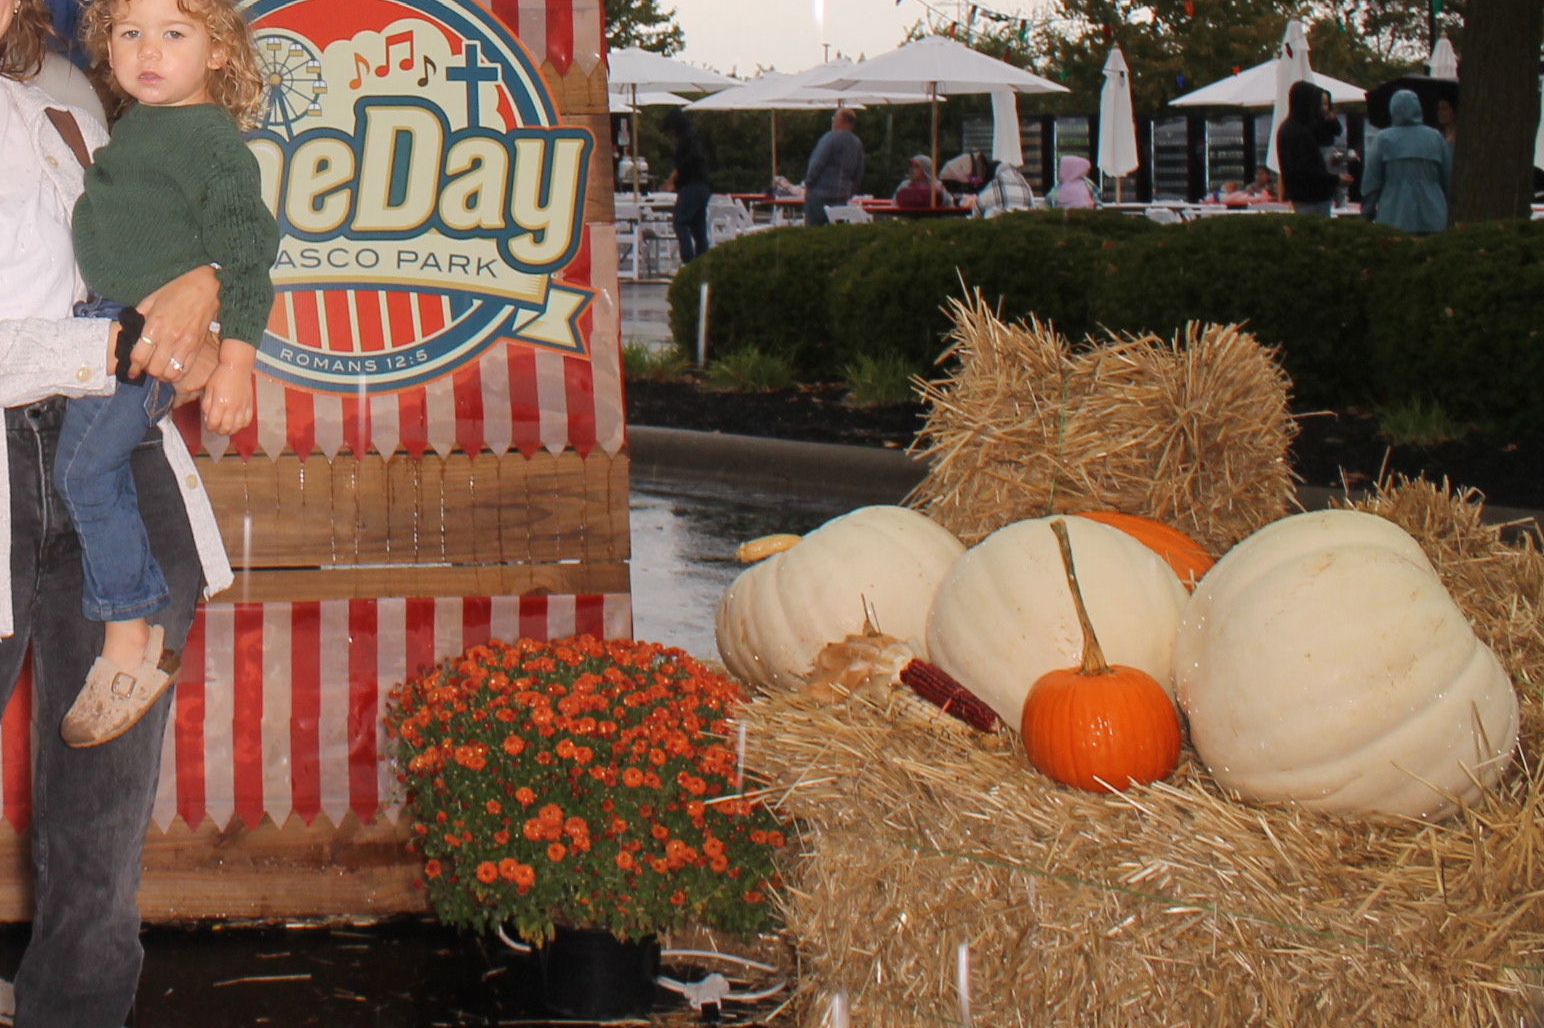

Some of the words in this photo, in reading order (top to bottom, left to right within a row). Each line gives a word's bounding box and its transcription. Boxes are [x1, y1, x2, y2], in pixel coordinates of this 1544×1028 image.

[245, 104, 586, 265] eDay
[273, 247, 380, 271] ASCO
[396, 250, 498, 279] PARK
[280, 348, 377, 372] ROMANS
[386, 349, 428, 370] 12:5
